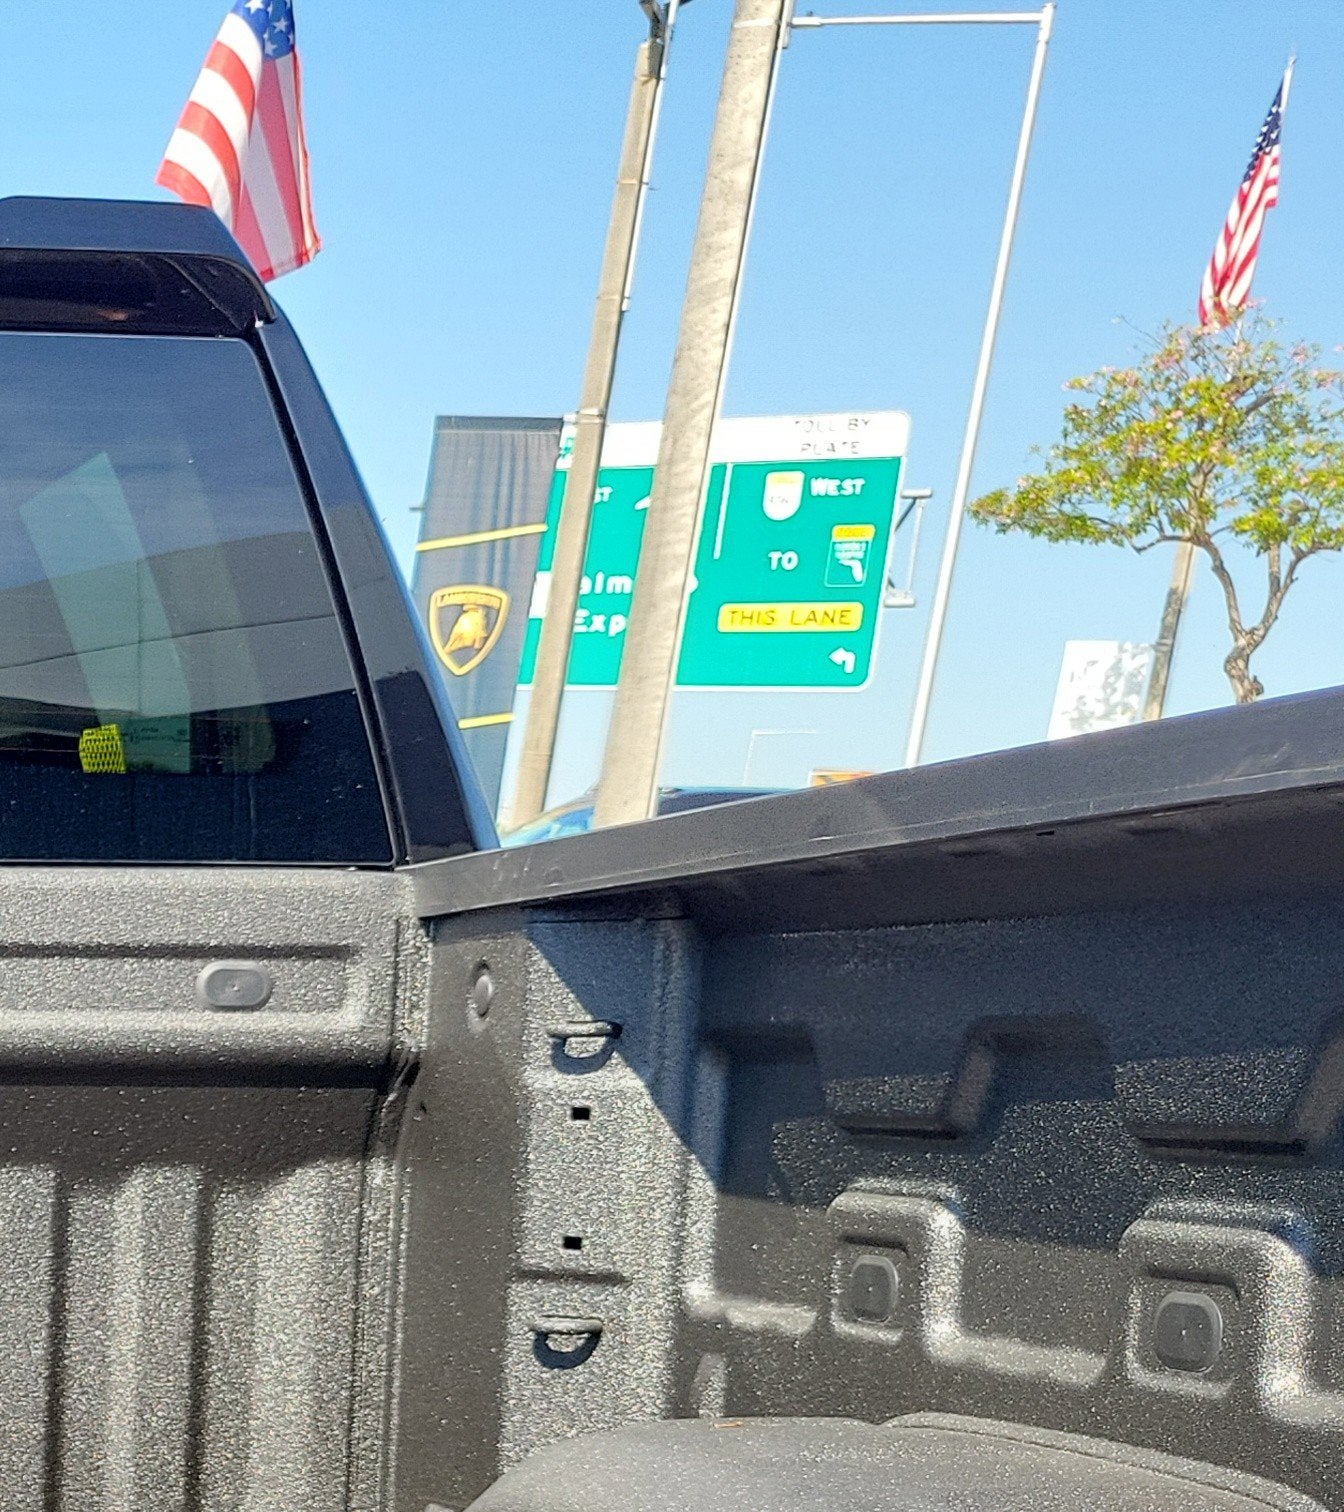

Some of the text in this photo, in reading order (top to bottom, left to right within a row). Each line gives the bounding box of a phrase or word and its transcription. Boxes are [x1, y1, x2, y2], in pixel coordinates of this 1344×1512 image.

[809, 477, 866, 497] WEST
[767, 550, 799, 571] TO
[573, 608, 627, 637] Exp
[728, 609, 853, 627] THIS LANE
